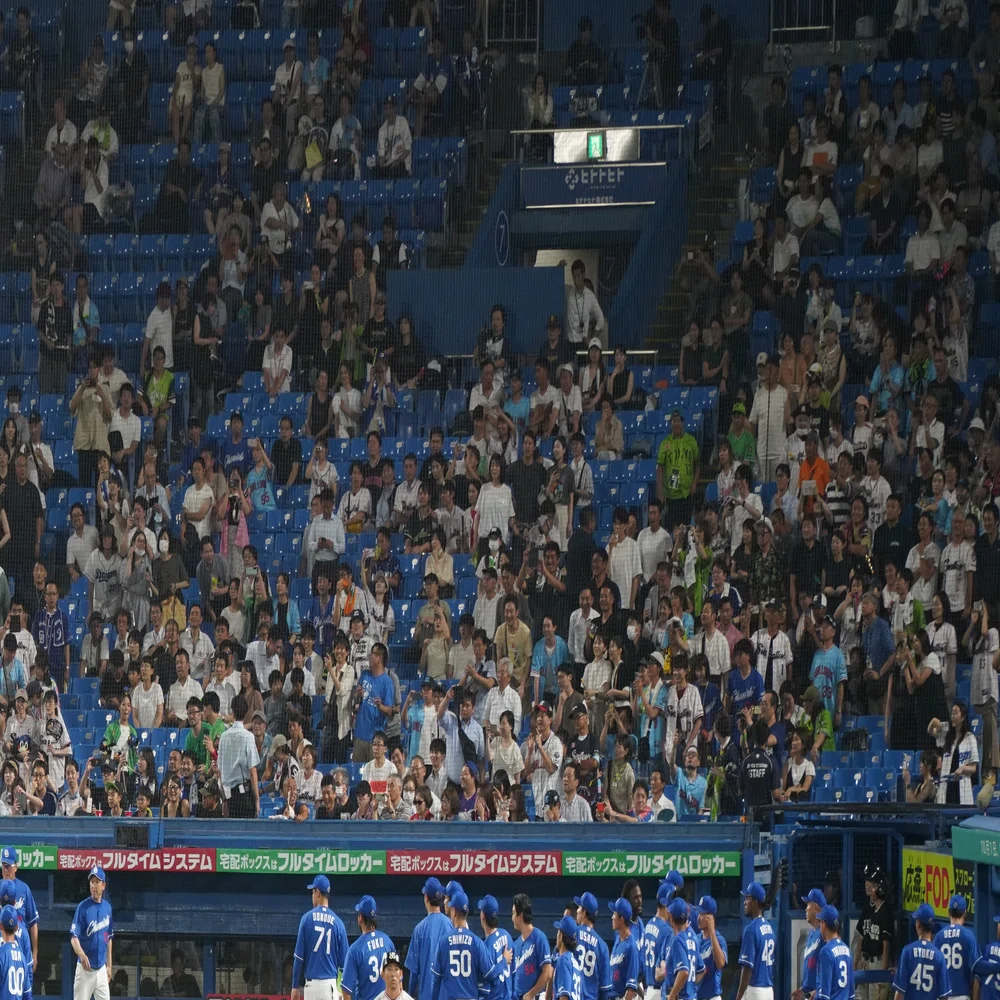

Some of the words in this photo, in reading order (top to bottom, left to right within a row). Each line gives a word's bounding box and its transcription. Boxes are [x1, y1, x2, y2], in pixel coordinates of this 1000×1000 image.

[581, 167, 625, 184] ヒトトヒト
[748, 768, 766, 778] STAFF
[59, 852, 212, 871] 宅配ボックスはフルタイムシステム
[219, 852, 383, 873] 宅配ボックスはフルタイムロッカー
[390, 854, 558, 874] 宅配ボックスはフルタイムシステム
[565, 855, 736, 876] 宅配ボックスはフルタイムロッカー
[925, 865, 950, 909] FOD
[313, 926, 332, 955] 71
[367, 937, 384, 952] FUKU
[579, 930, 598, 948] USAMI
[449, 949, 472, 978] 50
[576, 944, 597, 978] 39
[761, 939, 775, 967] 42
[913, 947, 935, 960] RYUKU
[8, 966, 25, 998] 00
[837, 960, 848, 989] 3
[910, 963, 935, 993] 45
